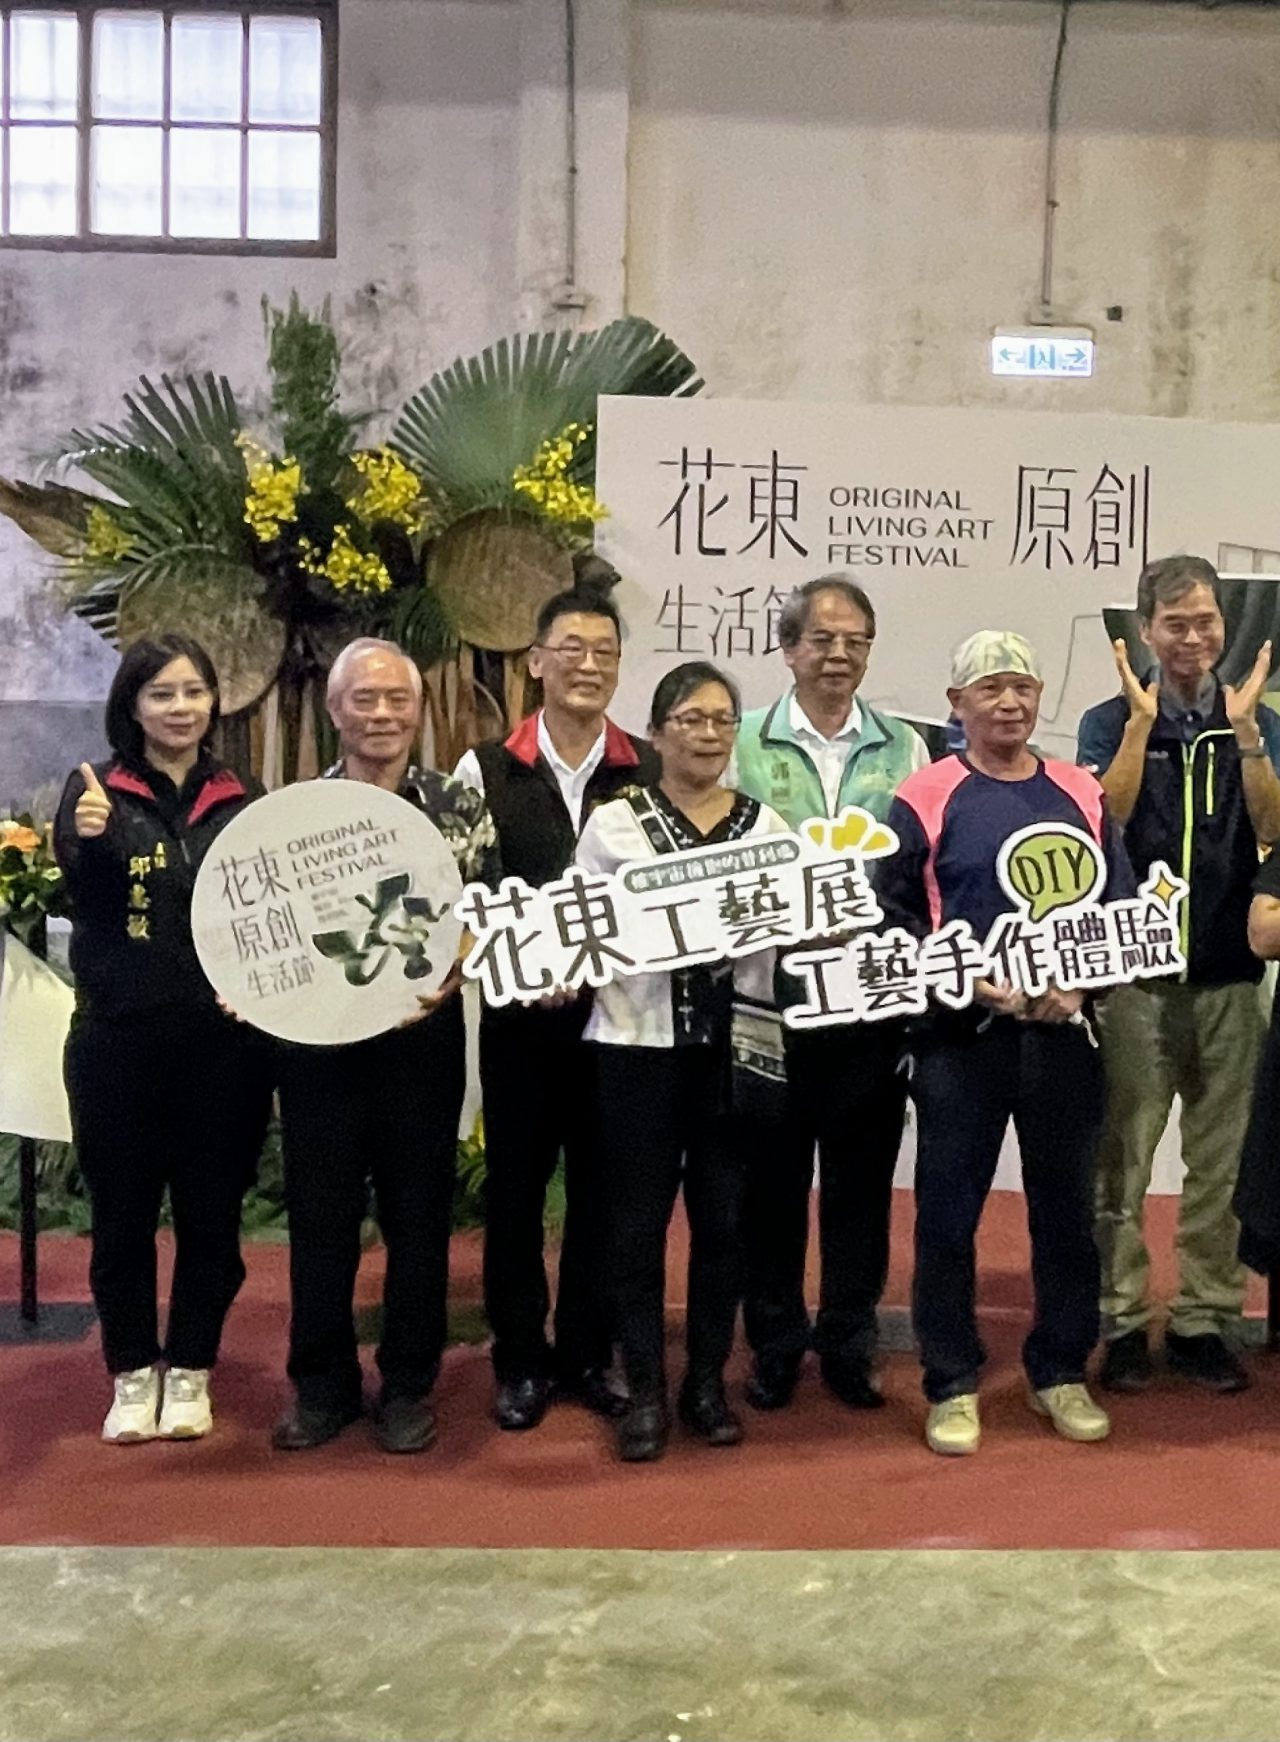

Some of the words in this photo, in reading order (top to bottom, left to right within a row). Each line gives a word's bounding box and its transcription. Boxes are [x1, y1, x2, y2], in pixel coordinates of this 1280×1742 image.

[657, 447, 809, 560] 花東
[829, 486, 971, 511] ORIGINAL
[1009, 463, 1150, 571] 原創
[828, 515, 927, 539] LIVING
[935, 518, 995, 540] ART
[828, 543, 969, 568] FESTIVAL
[286, 818, 381, 855] ORIGINAL
[291, 842, 358, 873] LIVING
[362, 829, 399, 851] ART
[212, 846, 291, 911] 花東
[297, 852, 391, 890] FESTIVAL
[1013, 842, 1088, 897] DIY
[230, 901, 304, 963] 原創
[462, 858, 877, 998] 花東工藝展
[794, 902, 1181, 1019] 工藝手作體驗
